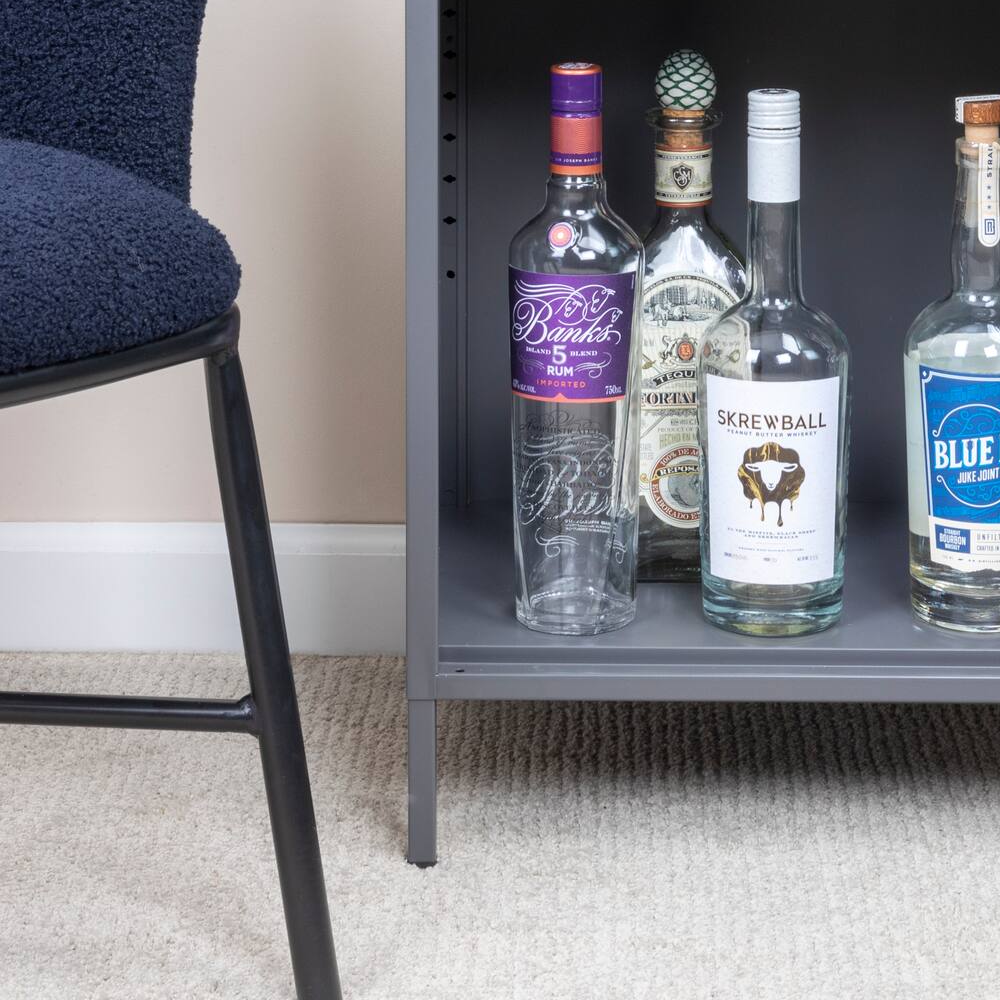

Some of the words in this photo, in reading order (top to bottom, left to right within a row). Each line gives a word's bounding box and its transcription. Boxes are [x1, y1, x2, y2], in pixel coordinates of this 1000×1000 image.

[512, 292, 622, 344] Banks
[526, 346, 551, 355] ISLAND
[552, 344, 567, 365] 5
[547, 365, 574, 377] RUM
[537, 379, 587, 388] IMPORTED
[717, 409, 827, 430] SKREWBALL
[727, 428, 753, 437] PEANUT
[787, 430, 818, 438] WHISKEY
[660, 453, 677, 466] 100%
[678, 448, 689, 457] DE
[934, 436, 995, 469] BLUE
[957, 470, 977, 484] JUKE
[977, 467, 999, 481] JOINT
[652, 483, 690, 520] ELABORADO
[939, 532, 966, 546] BOURBON
[944, 543, 960, 551] WHISKEY
